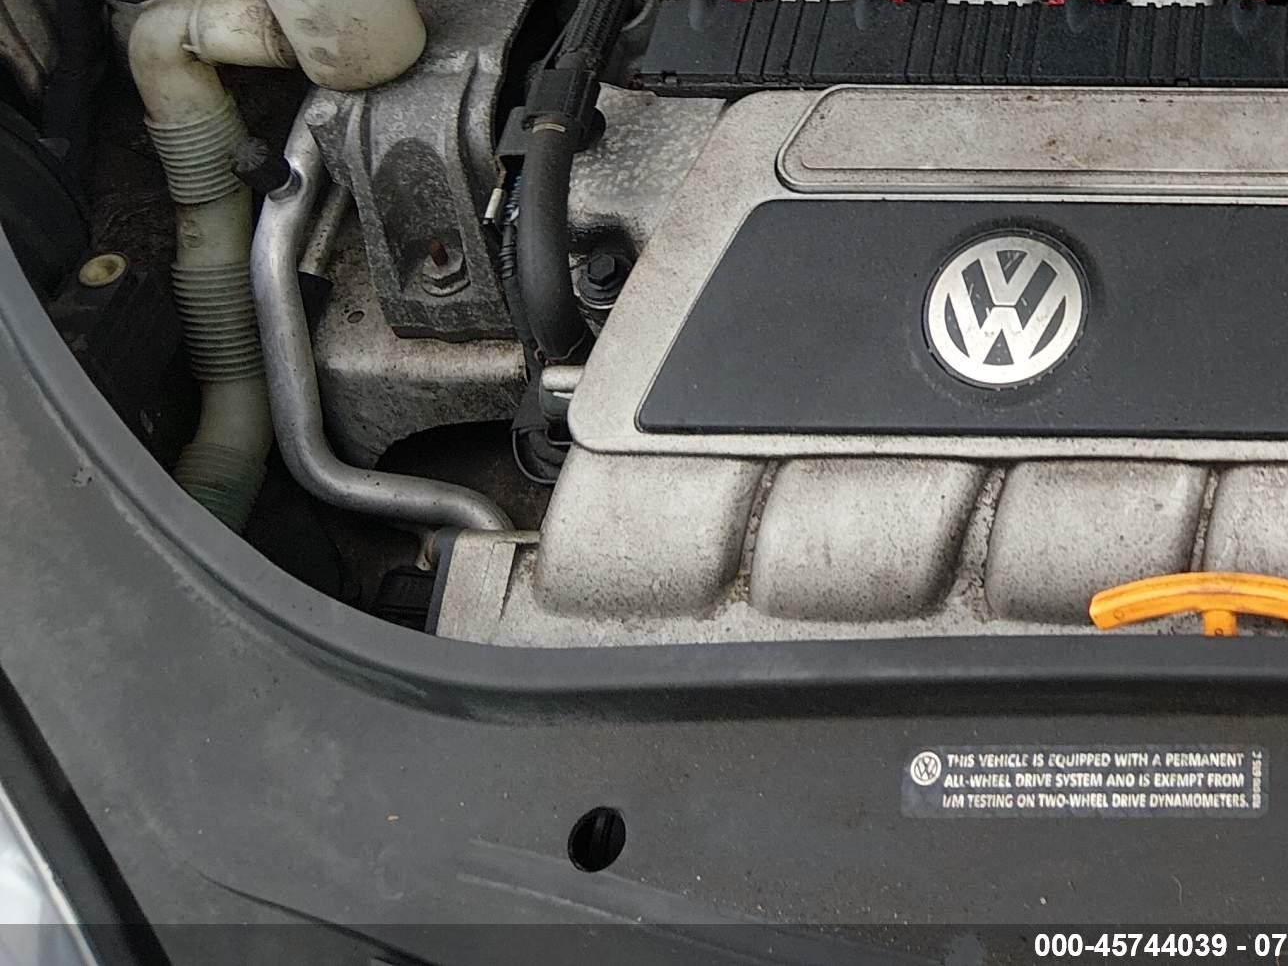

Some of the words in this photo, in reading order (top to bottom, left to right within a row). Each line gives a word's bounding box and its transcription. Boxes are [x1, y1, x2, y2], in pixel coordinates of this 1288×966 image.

[947, 754, 975, 767] THIS
[978, 754, 1029, 768] VEHICLE
[1032, 754, 1045, 767] IS
[1048, 754, 1111, 768] EQUIPPED
[1115, 754, 1149, 767] WITH
[1152, 754, 1161, 767] A
[1165, 754, 1245, 767] PERMANENT
[943, 773, 1012, 788] ALL-WHEEL
[1015, 774, 1052, 787] DRIVE
[1056, 774, 1103, 788] SYSTEM
[1106, 774, 1135, 787] AND
[1139, 774, 1151, 787] IS
[1154, 774, 1204, 788] EXEMPT
[1207, 773, 1245, 787] FROM
[968, 794, 1014, 808] TESTING
[1017, 794, 1036, 808] ON
[1039, 794, 1109, 808] TWO-WHEEL
[1112, 794, 1146, 808] DRIVE
[1150, 794, 1249, 808] DYNAMOMETERS.
